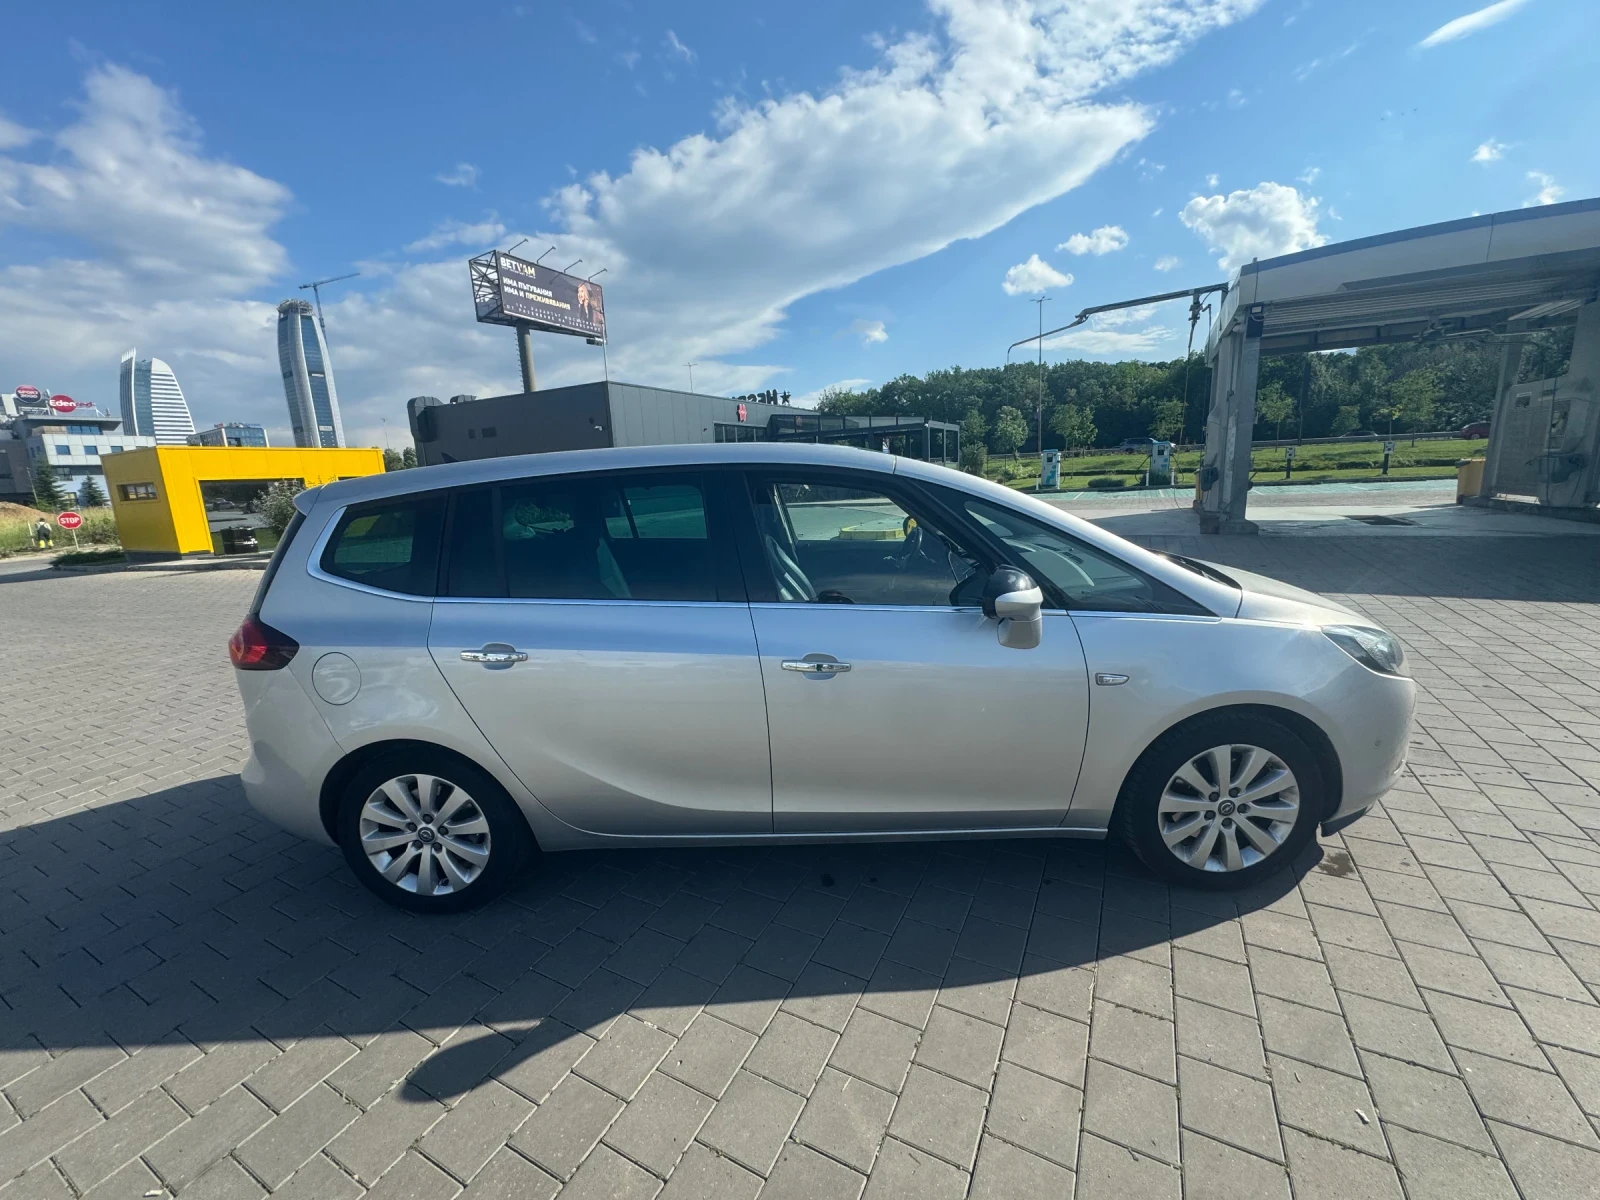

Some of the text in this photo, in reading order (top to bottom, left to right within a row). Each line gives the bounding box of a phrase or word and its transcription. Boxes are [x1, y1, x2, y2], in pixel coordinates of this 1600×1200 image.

[502, 276, 553, 297] ИМА ПЪТУВАНИЯ
[503, 285, 519, 296] ИМА
[519, 289, 525, 298] И
